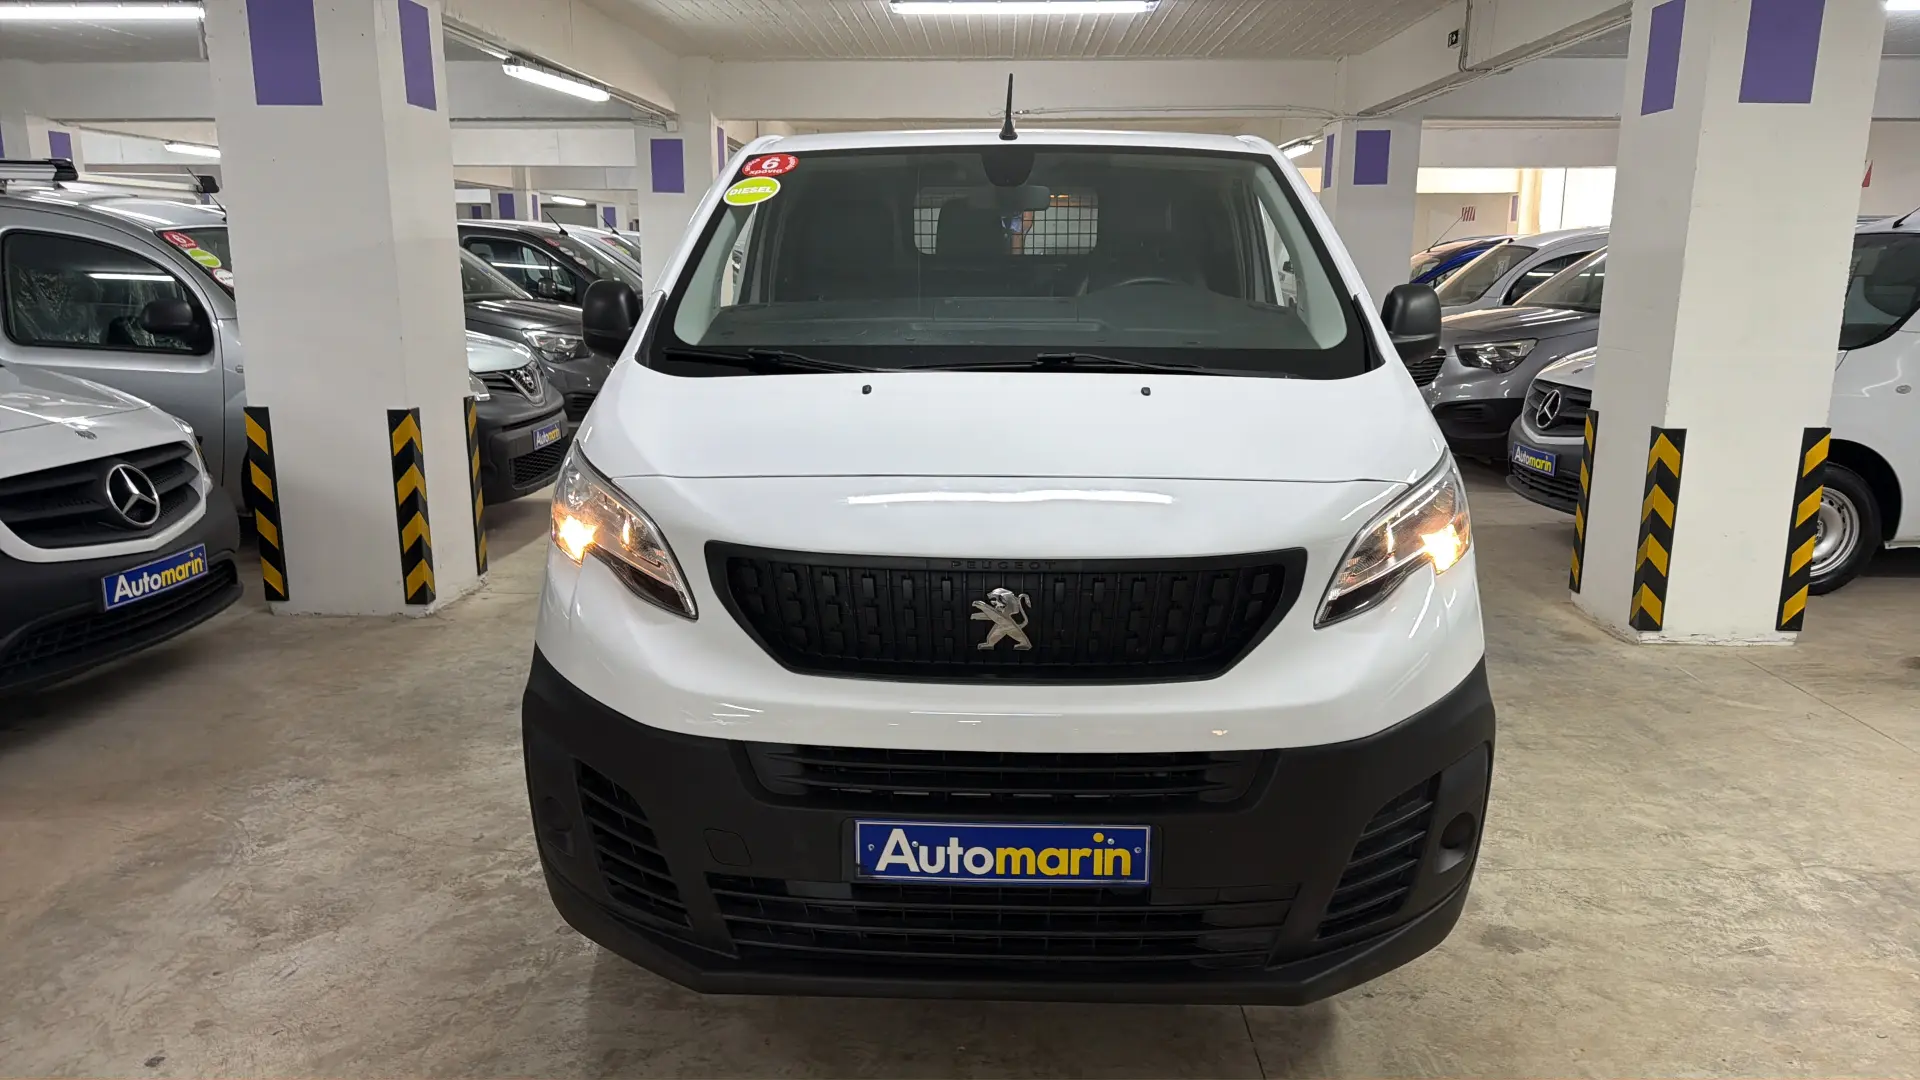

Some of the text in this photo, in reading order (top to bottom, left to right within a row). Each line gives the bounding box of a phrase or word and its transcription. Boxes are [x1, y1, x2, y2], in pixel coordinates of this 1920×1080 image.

[761, 158, 781, 170] 6
[729, 186, 773, 196] DIESEL
[1515, 445, 1552, 472] Automarin
[951, 560, 1056, 570] PEUGEOT
[113, 551, 204, 603] Automarin
[875, 828, 1131, 876] Automarin
